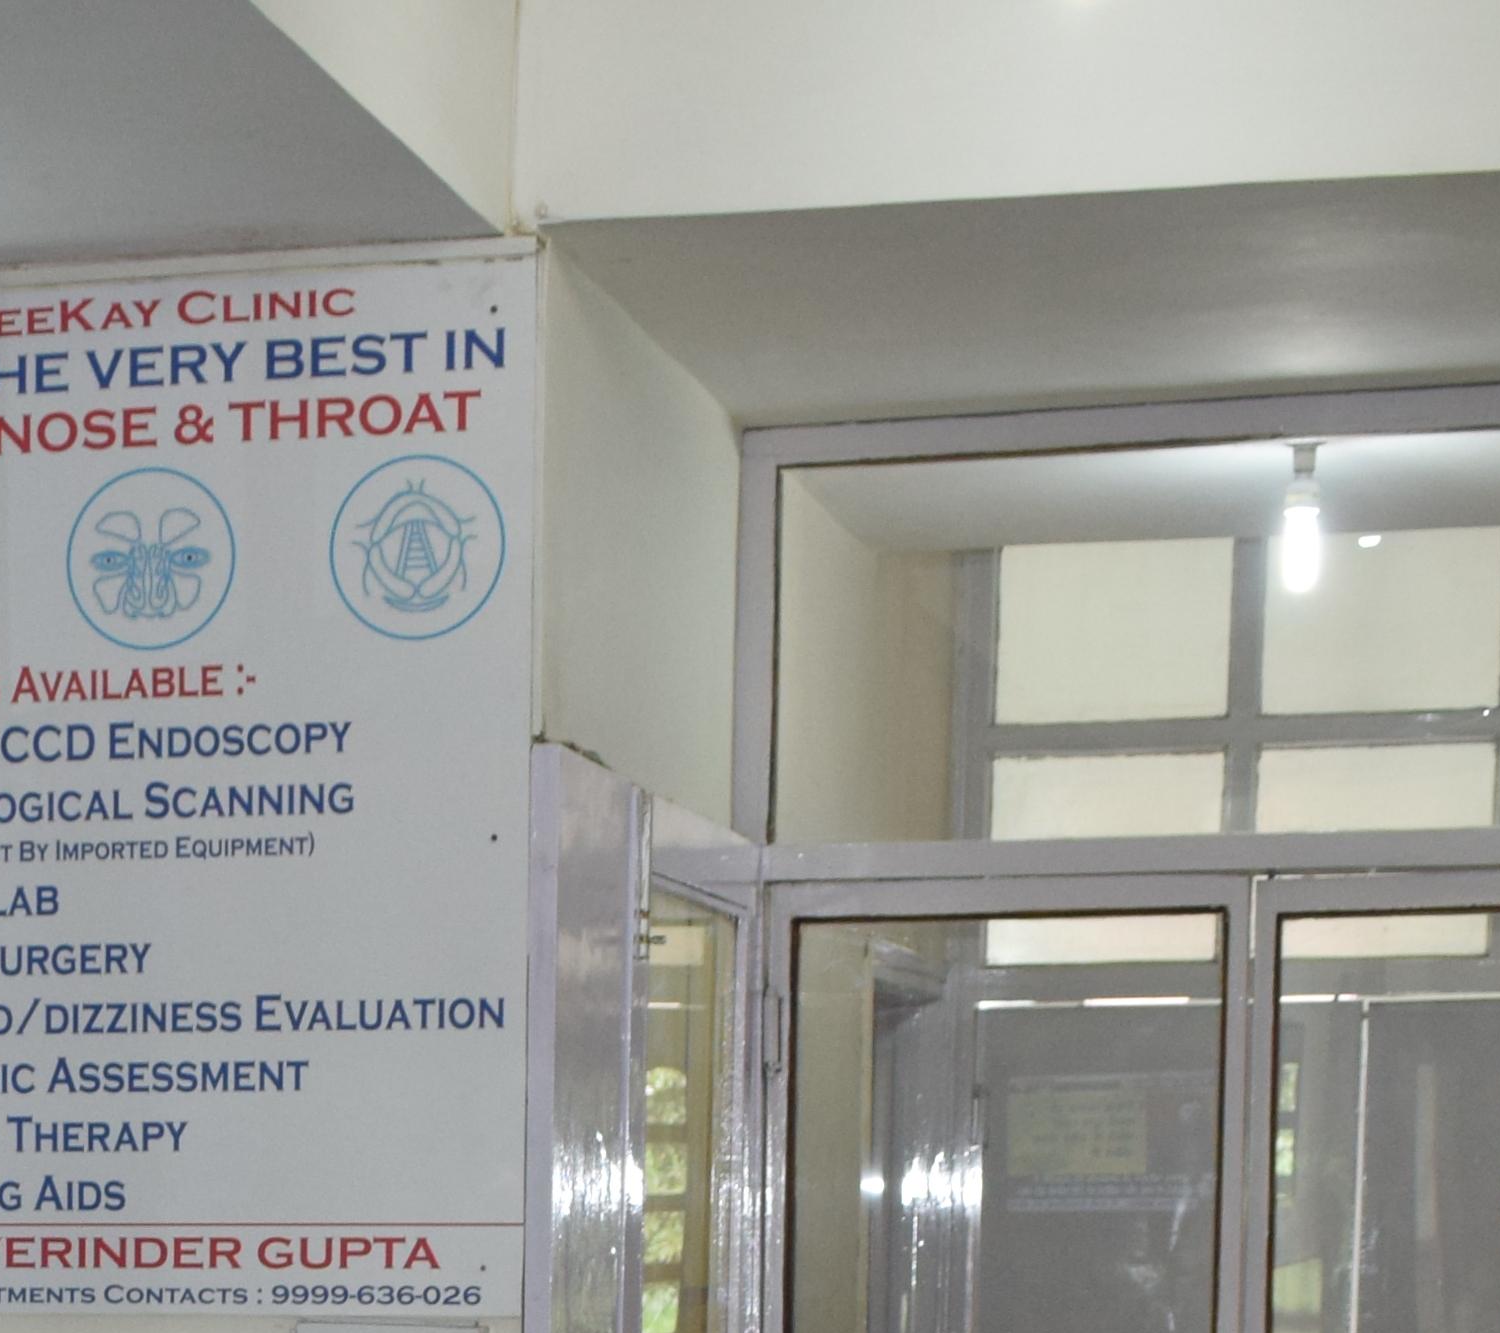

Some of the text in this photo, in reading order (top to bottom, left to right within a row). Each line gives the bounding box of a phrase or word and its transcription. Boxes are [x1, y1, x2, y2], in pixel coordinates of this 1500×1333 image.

[176, 287, 356, 326] CLINIC
[85, 340, 248, 391] VERY
[265, 330, 428, 381] BEST
[444, 326, 506, 372] IN
[173, 403, 215, 447] &
[227, 389, 482, 443] THROAT
[10, 664, 224, 704] AVAILABLE
[0, 723, 96, 764] CCD
[108, 720, 352, 761] ENDOSCOPY
[144, 780, 355, 820] SCANNING
[19, 839, 49, 863] BY
[55, 839, 169, 862] IMPORTED
[175, 831, 315, 861] EQUIPMENT)
[255, 993, 505, 1033] EVALUATION
[46, 1056, 310, 1095] ASSESSMENT
[6, 1115, 189, 1154] THERAPY
[33, 1174, 127, 1212] AIDS
[257, 1236, 441, 1270] GUPTA
[103, 1283, 249, 1305] CONTACTS
[271, 1284, 482, 1307] 9999-636-026
